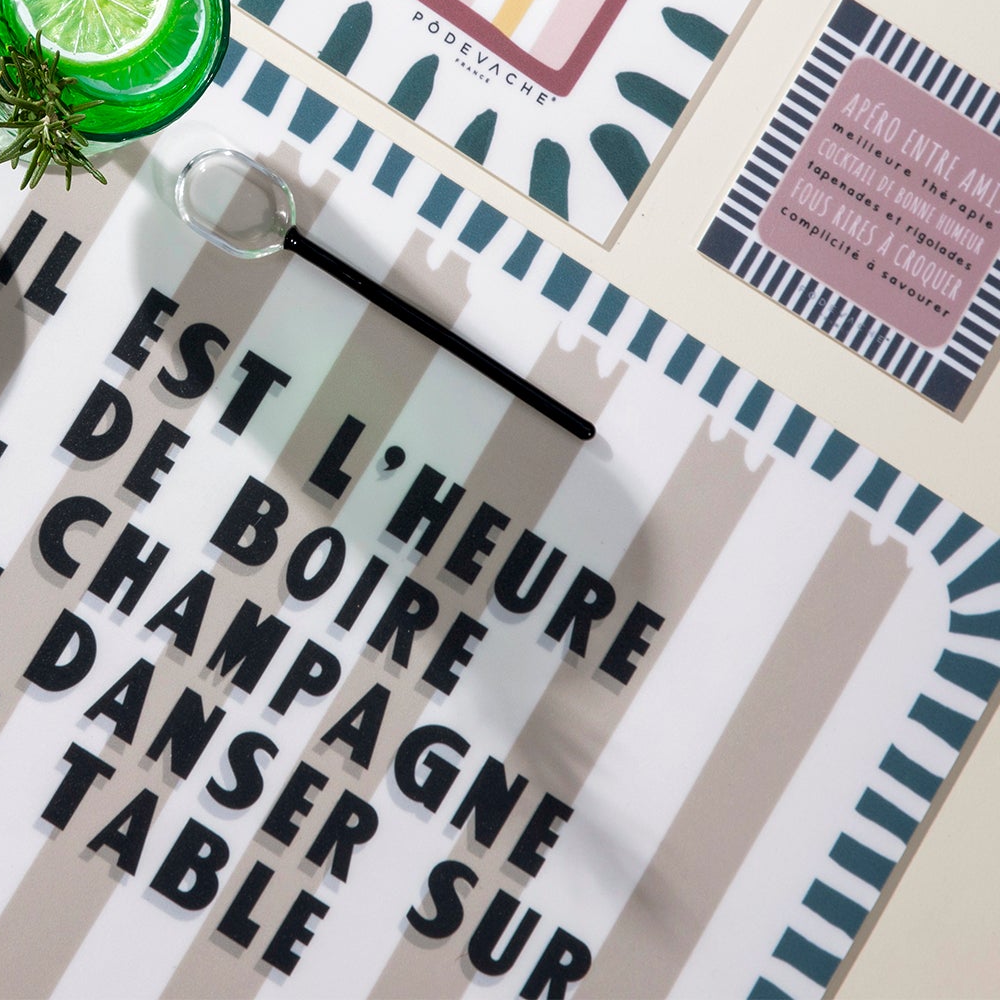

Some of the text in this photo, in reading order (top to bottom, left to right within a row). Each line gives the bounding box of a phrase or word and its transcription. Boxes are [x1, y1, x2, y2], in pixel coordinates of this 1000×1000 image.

[454, 57, 491, 84] FRANCE
[817, 137, 985, 256] COCKTAIL DE BONNE HUMEUR
[832, 121, 993, 230] meilleure thérapie
[841, 92, 1000, 214] APÉRO ENTRE AMI
[780, 204, 861, 261] complicité
[881, 270, 951, 319] savourer
[790, 177, 962, 302] FOUS RIRES À CROQUER
[807, 159, 972, 272] tapenades et rigolades
[59, 379, 489, 697] DE BOIRE
[111, 287, 292, 436] EST
[308, 414, 665, 687] L'HEURE
[37, 495, 575, 879] CHAMPAGNE
[22, 608, 379, 884] DANSER
[406, 860, 592, 1000] SUR
[40, 742, 330, 977] TABLE
